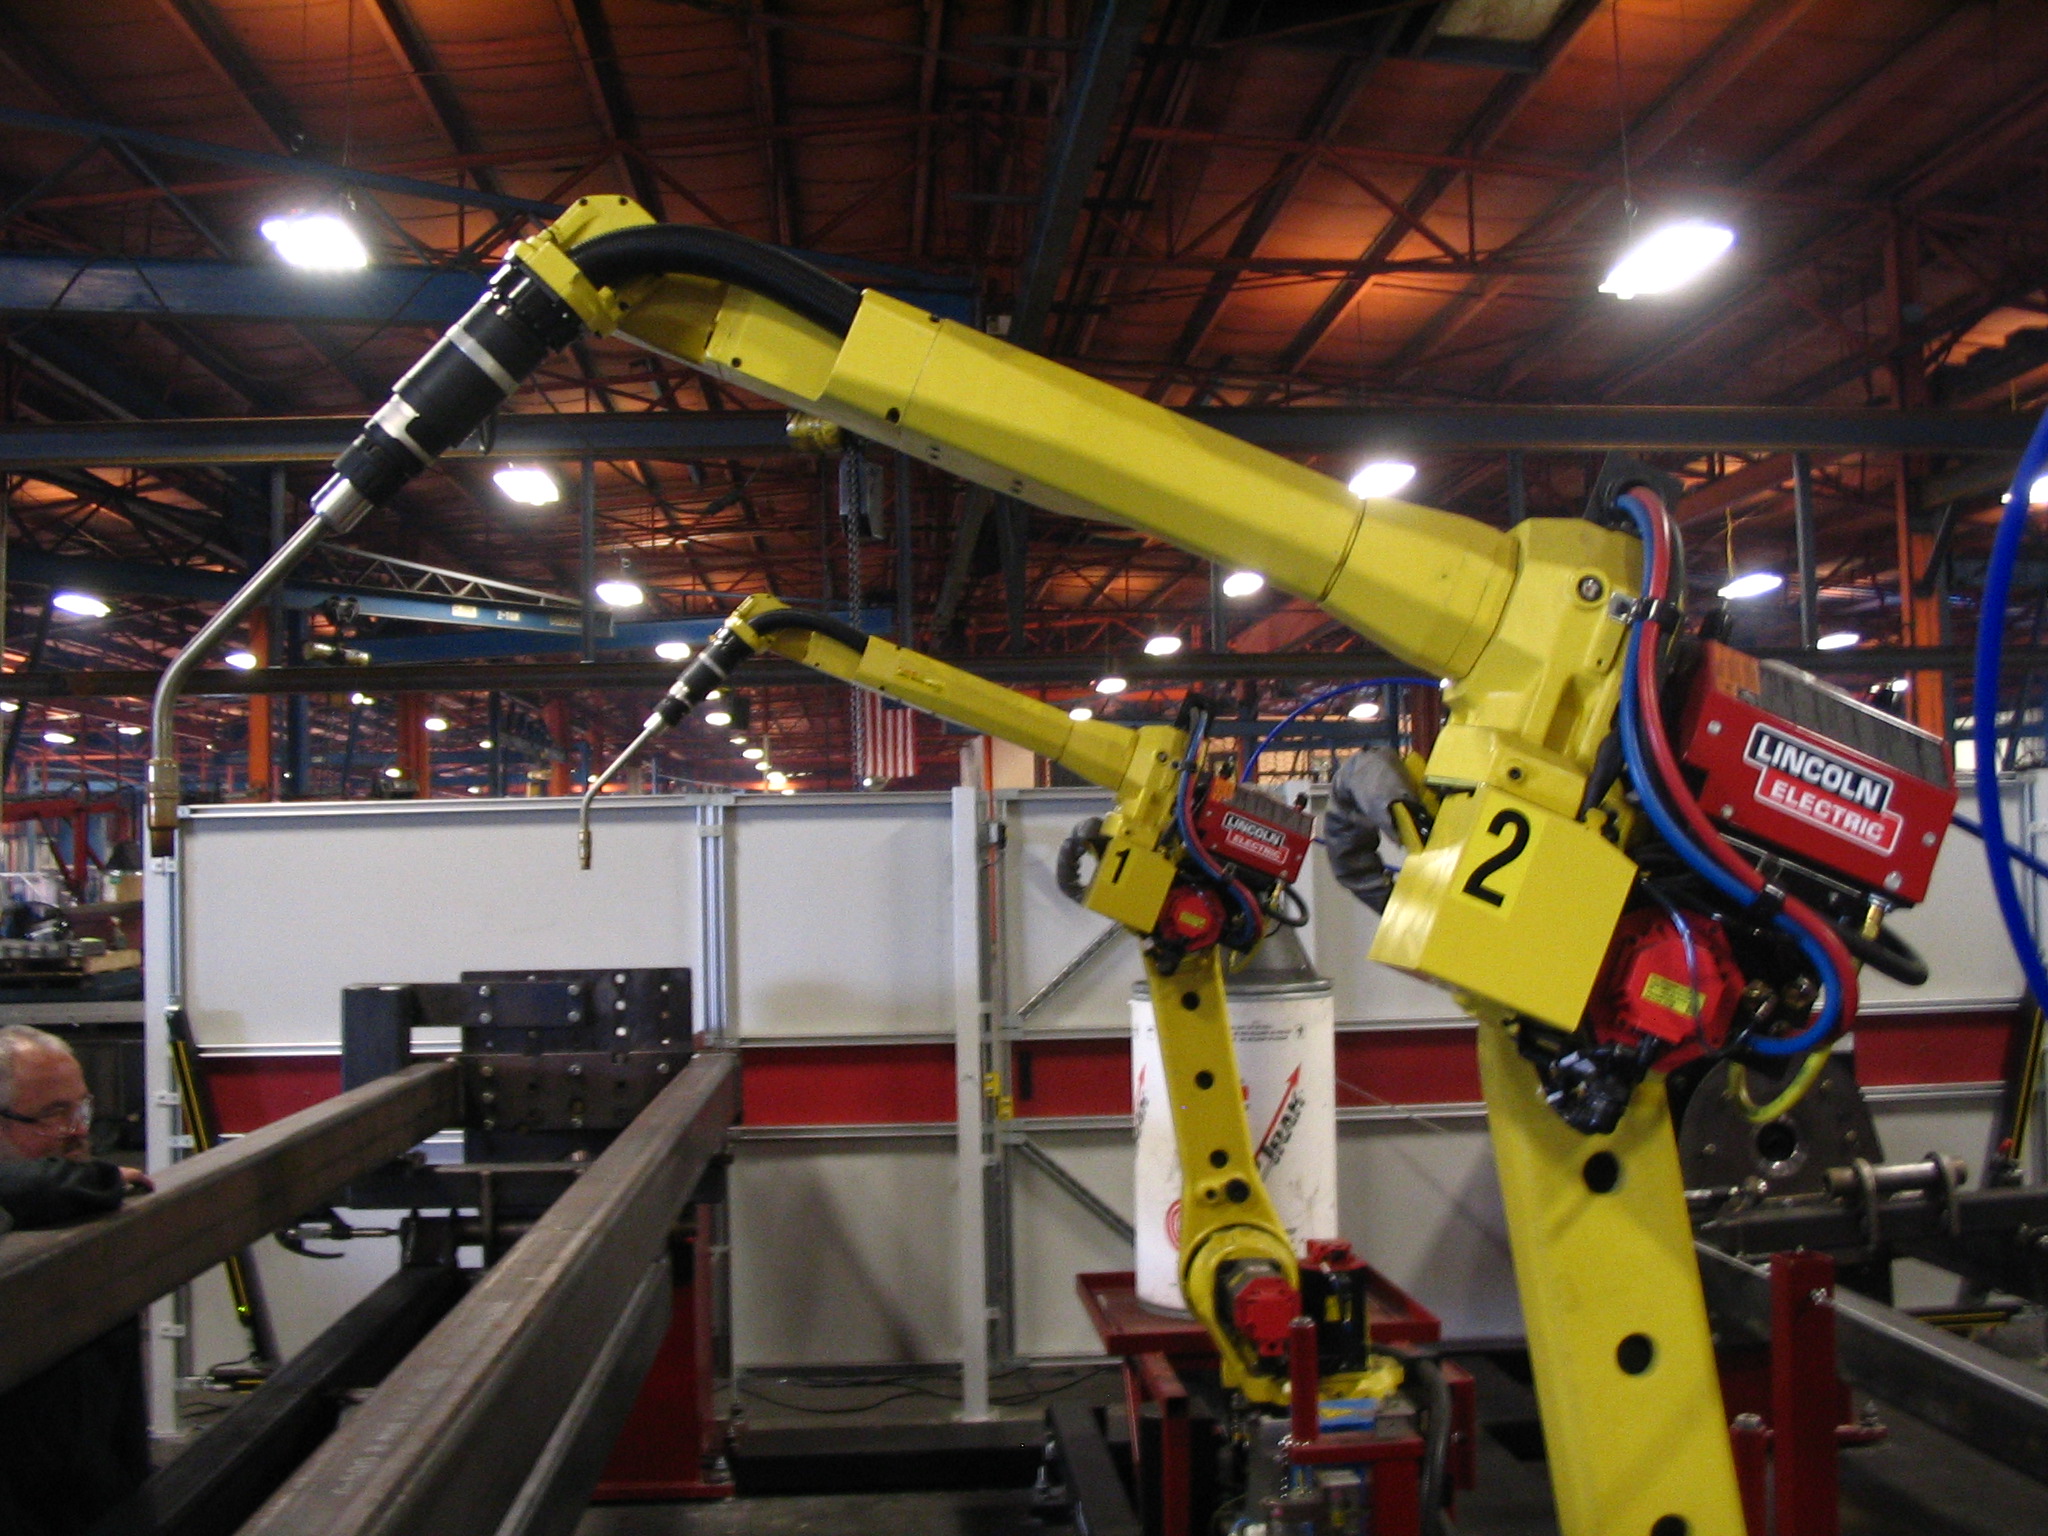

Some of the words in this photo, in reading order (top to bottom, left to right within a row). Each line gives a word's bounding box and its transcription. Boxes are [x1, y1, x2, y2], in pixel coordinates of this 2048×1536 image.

[1756, 735, 1882, 807] LINCOLN
[1227, 816, 1282, 847] LINCOLN
[1770, 780, 1885, 842] ELECTRIC
[1112, 848, 1131, 884] 1
[1463, 808, 1530, 907] 2
